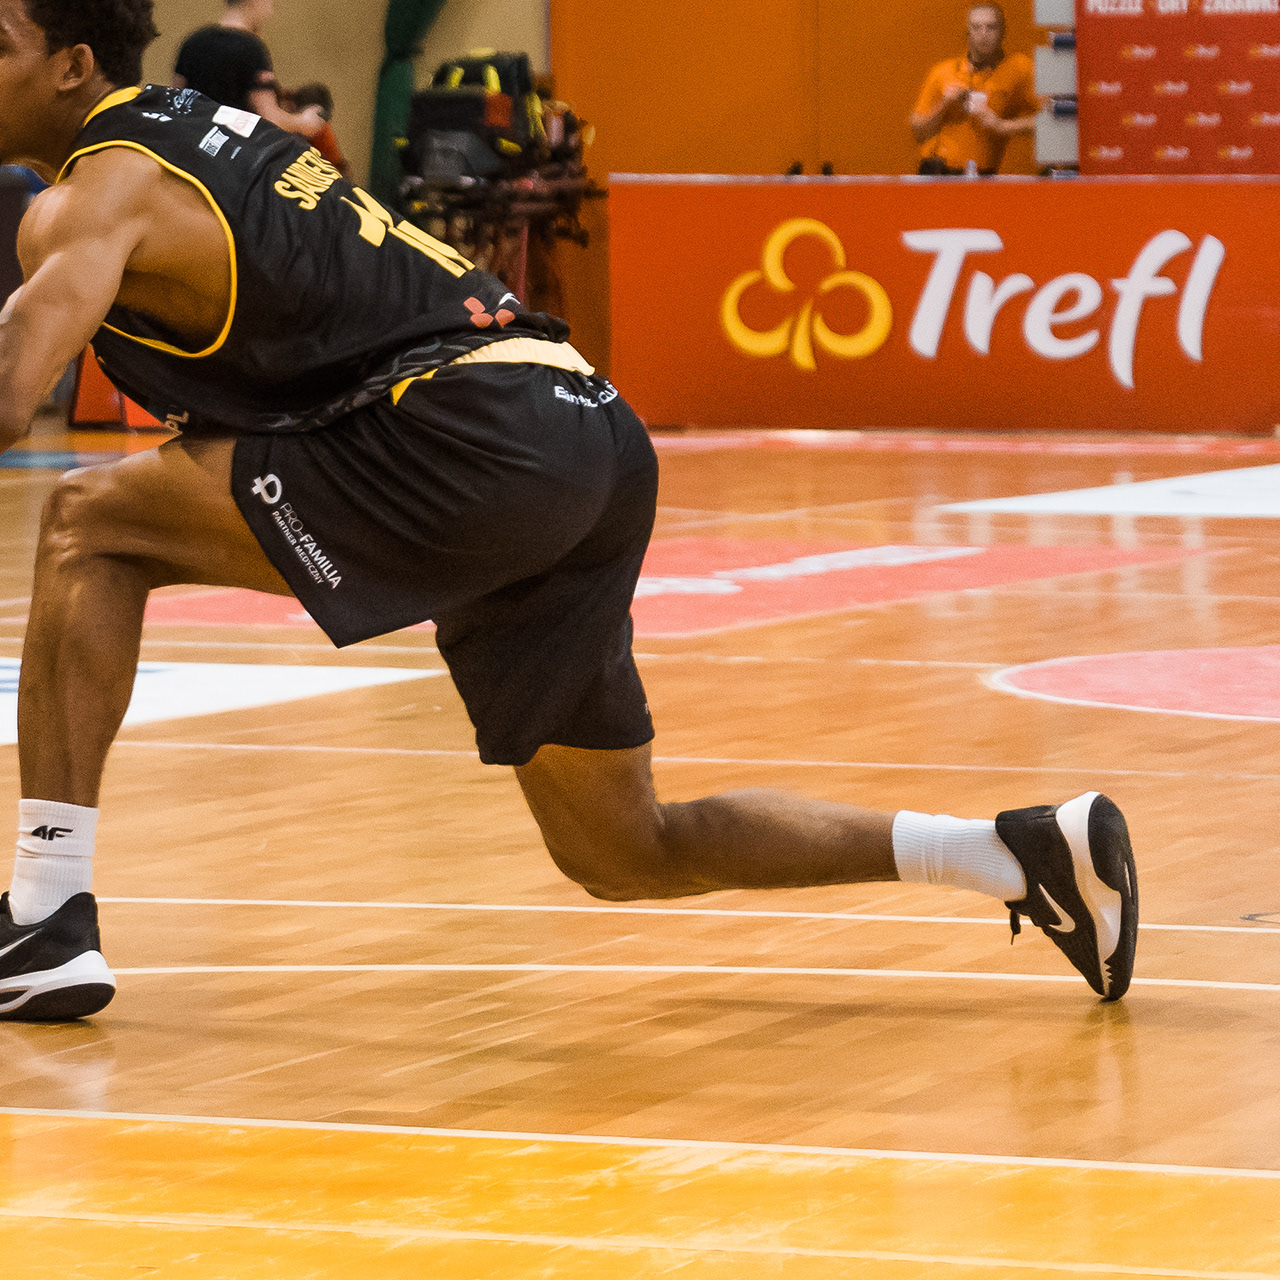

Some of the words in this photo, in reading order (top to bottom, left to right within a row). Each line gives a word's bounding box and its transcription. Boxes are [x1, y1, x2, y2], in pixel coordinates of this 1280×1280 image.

[901, 227, 1226, 389] Trefl
[271, 510, 297, 546] PARTNER
[294, 545, 325, 585] MEDYCZNY
[279, 502, 342, 590] PRO-FAMILIA
[31, 824, 73, 841] 4F
